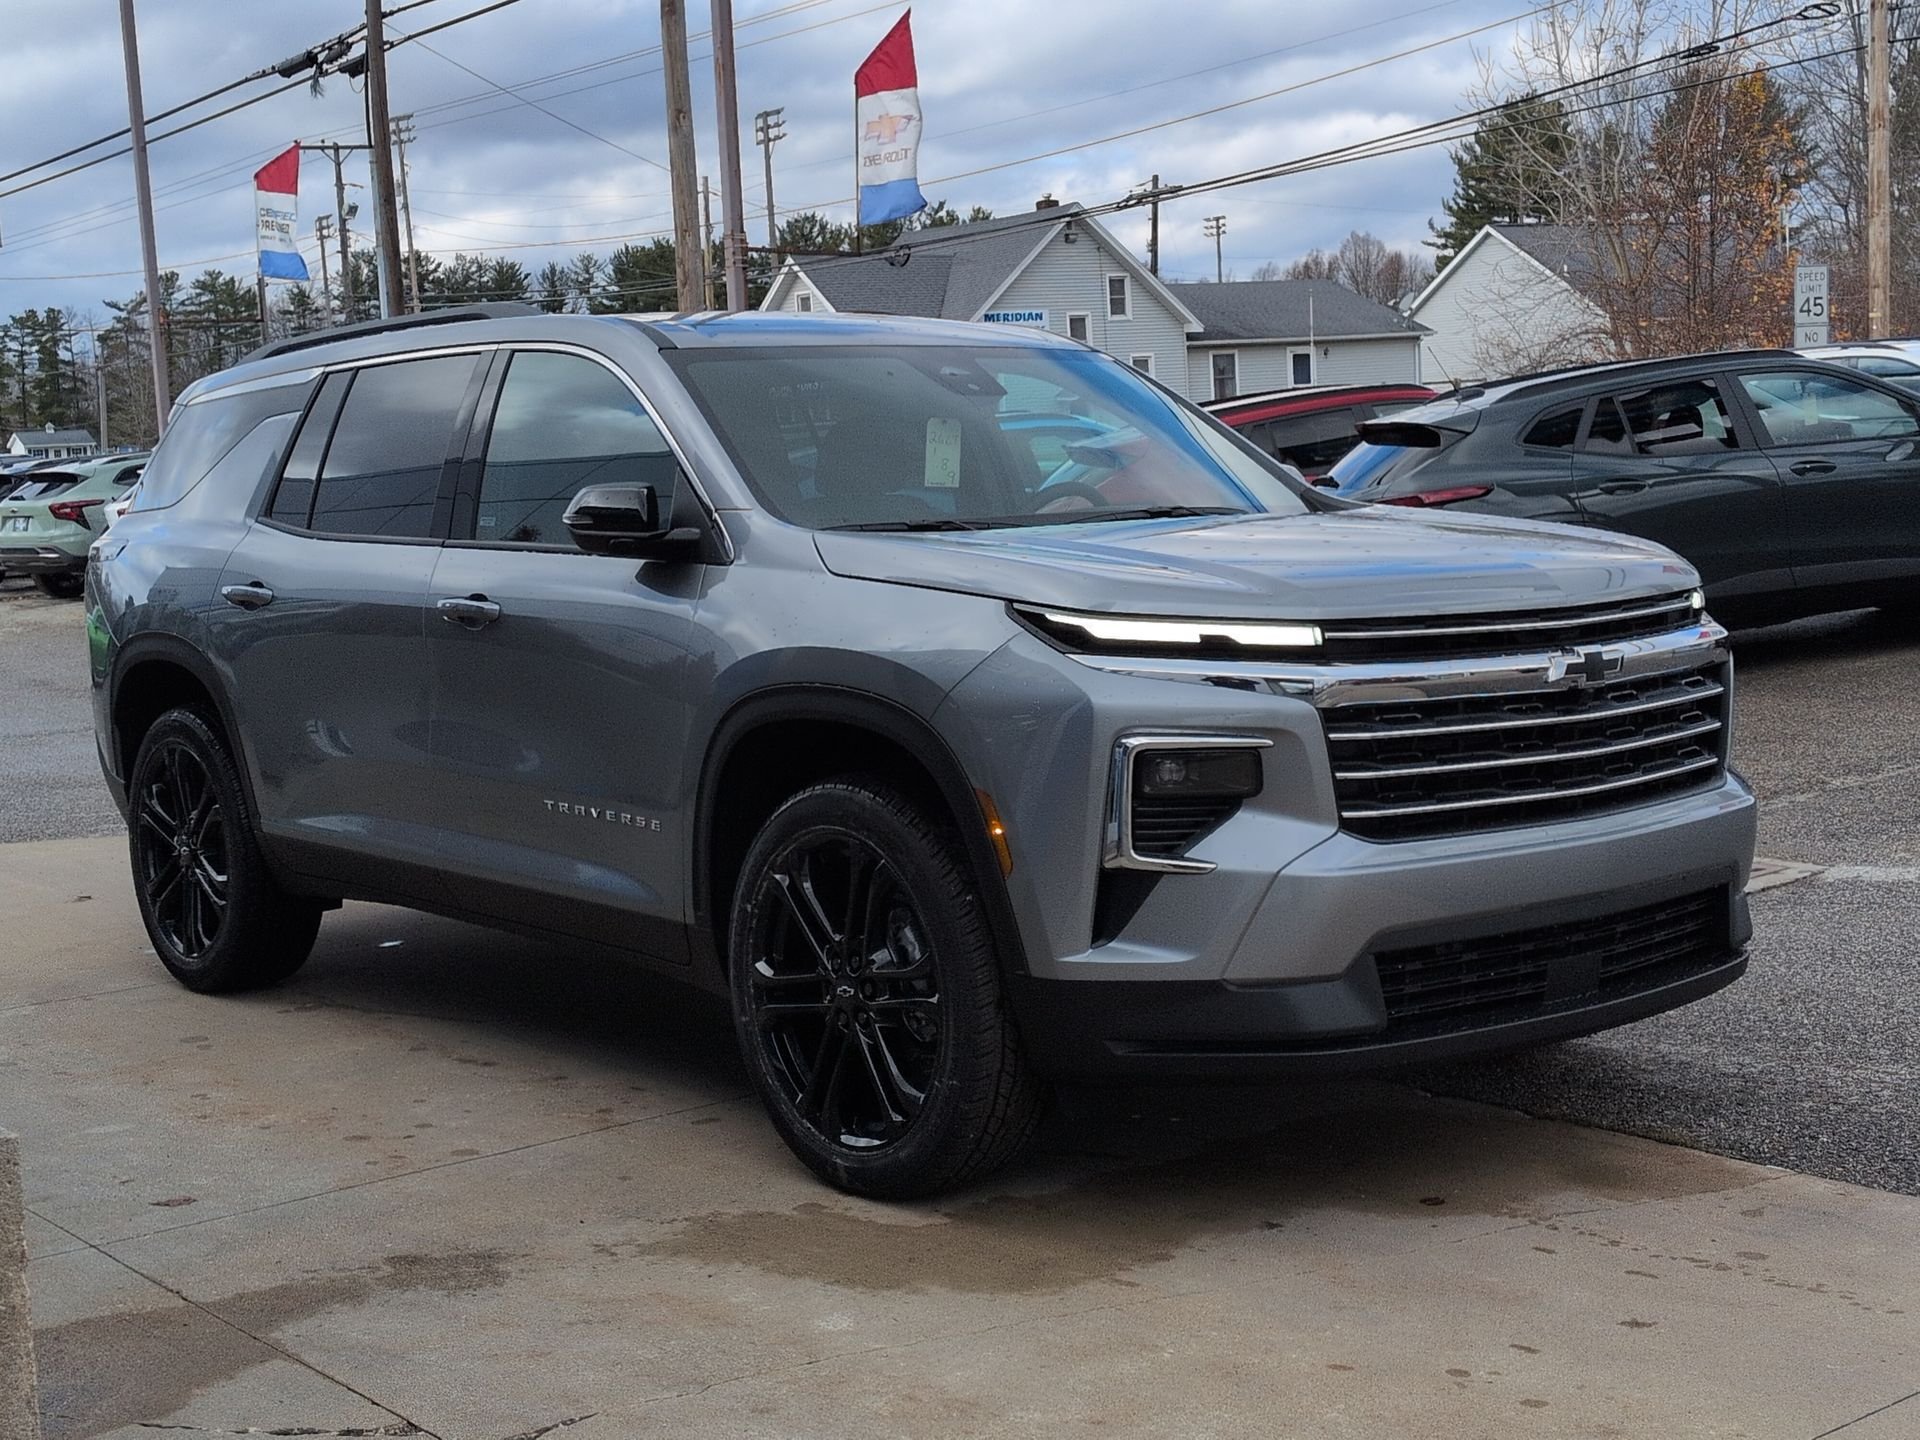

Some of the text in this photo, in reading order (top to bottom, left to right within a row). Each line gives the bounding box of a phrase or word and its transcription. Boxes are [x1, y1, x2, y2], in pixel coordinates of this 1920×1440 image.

[1798, 271, 1826, 281] SPEED
[1801, 284, 1822, 294] LIMIT
[1799, 296, 1824, 317] 45
[984, 312, 1043, 323] MERIDIAN
[1804, 331, 1819, 343] NO
[543, 799, 661, 832] TRAVERSE
